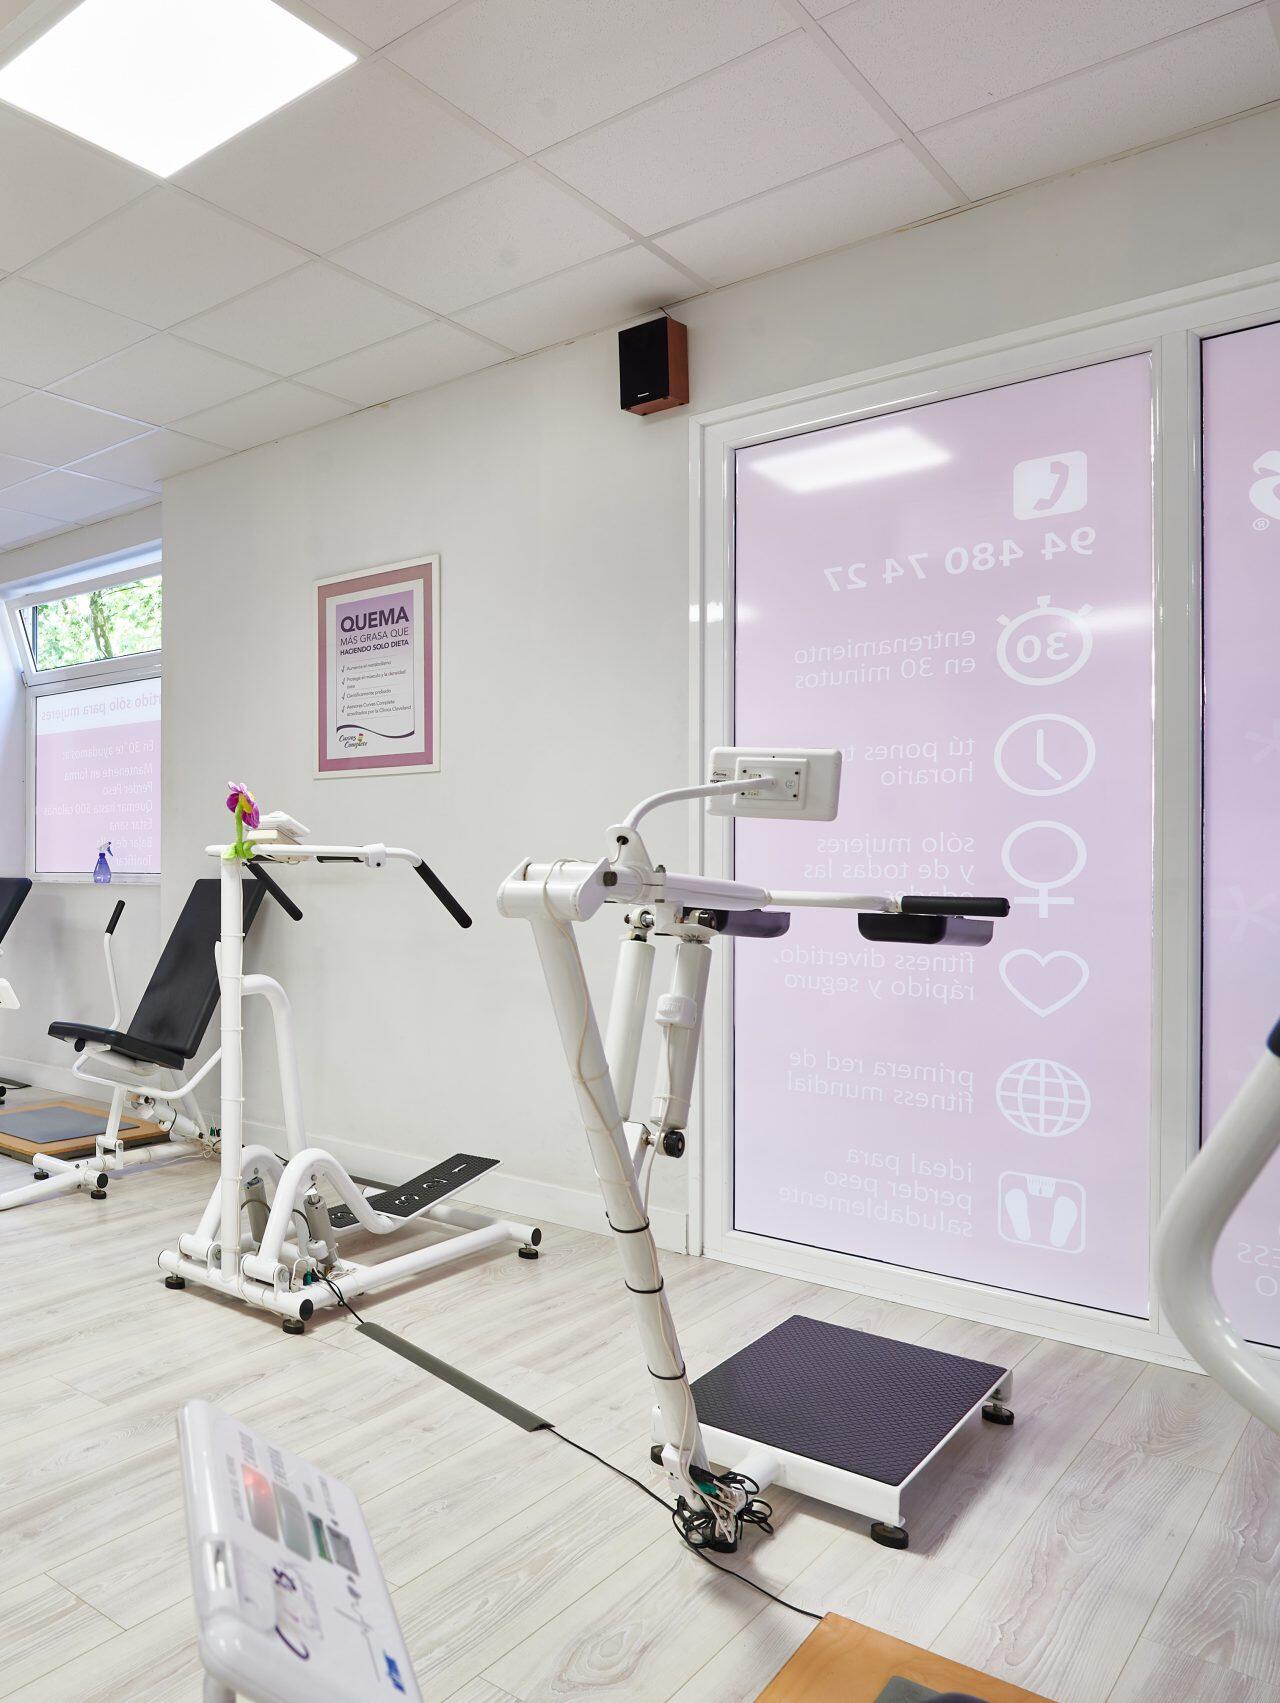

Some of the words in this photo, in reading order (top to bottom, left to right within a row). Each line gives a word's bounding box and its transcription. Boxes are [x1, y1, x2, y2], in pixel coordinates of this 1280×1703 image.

[340, 606, 409, 633] QUEMA
[360, 631, 388, 643] GRASA
[390, 627, 409, 637] QUE
[340, 646, 371, 655] HACIENDO
[372, 642, 389, 650] SOLO
